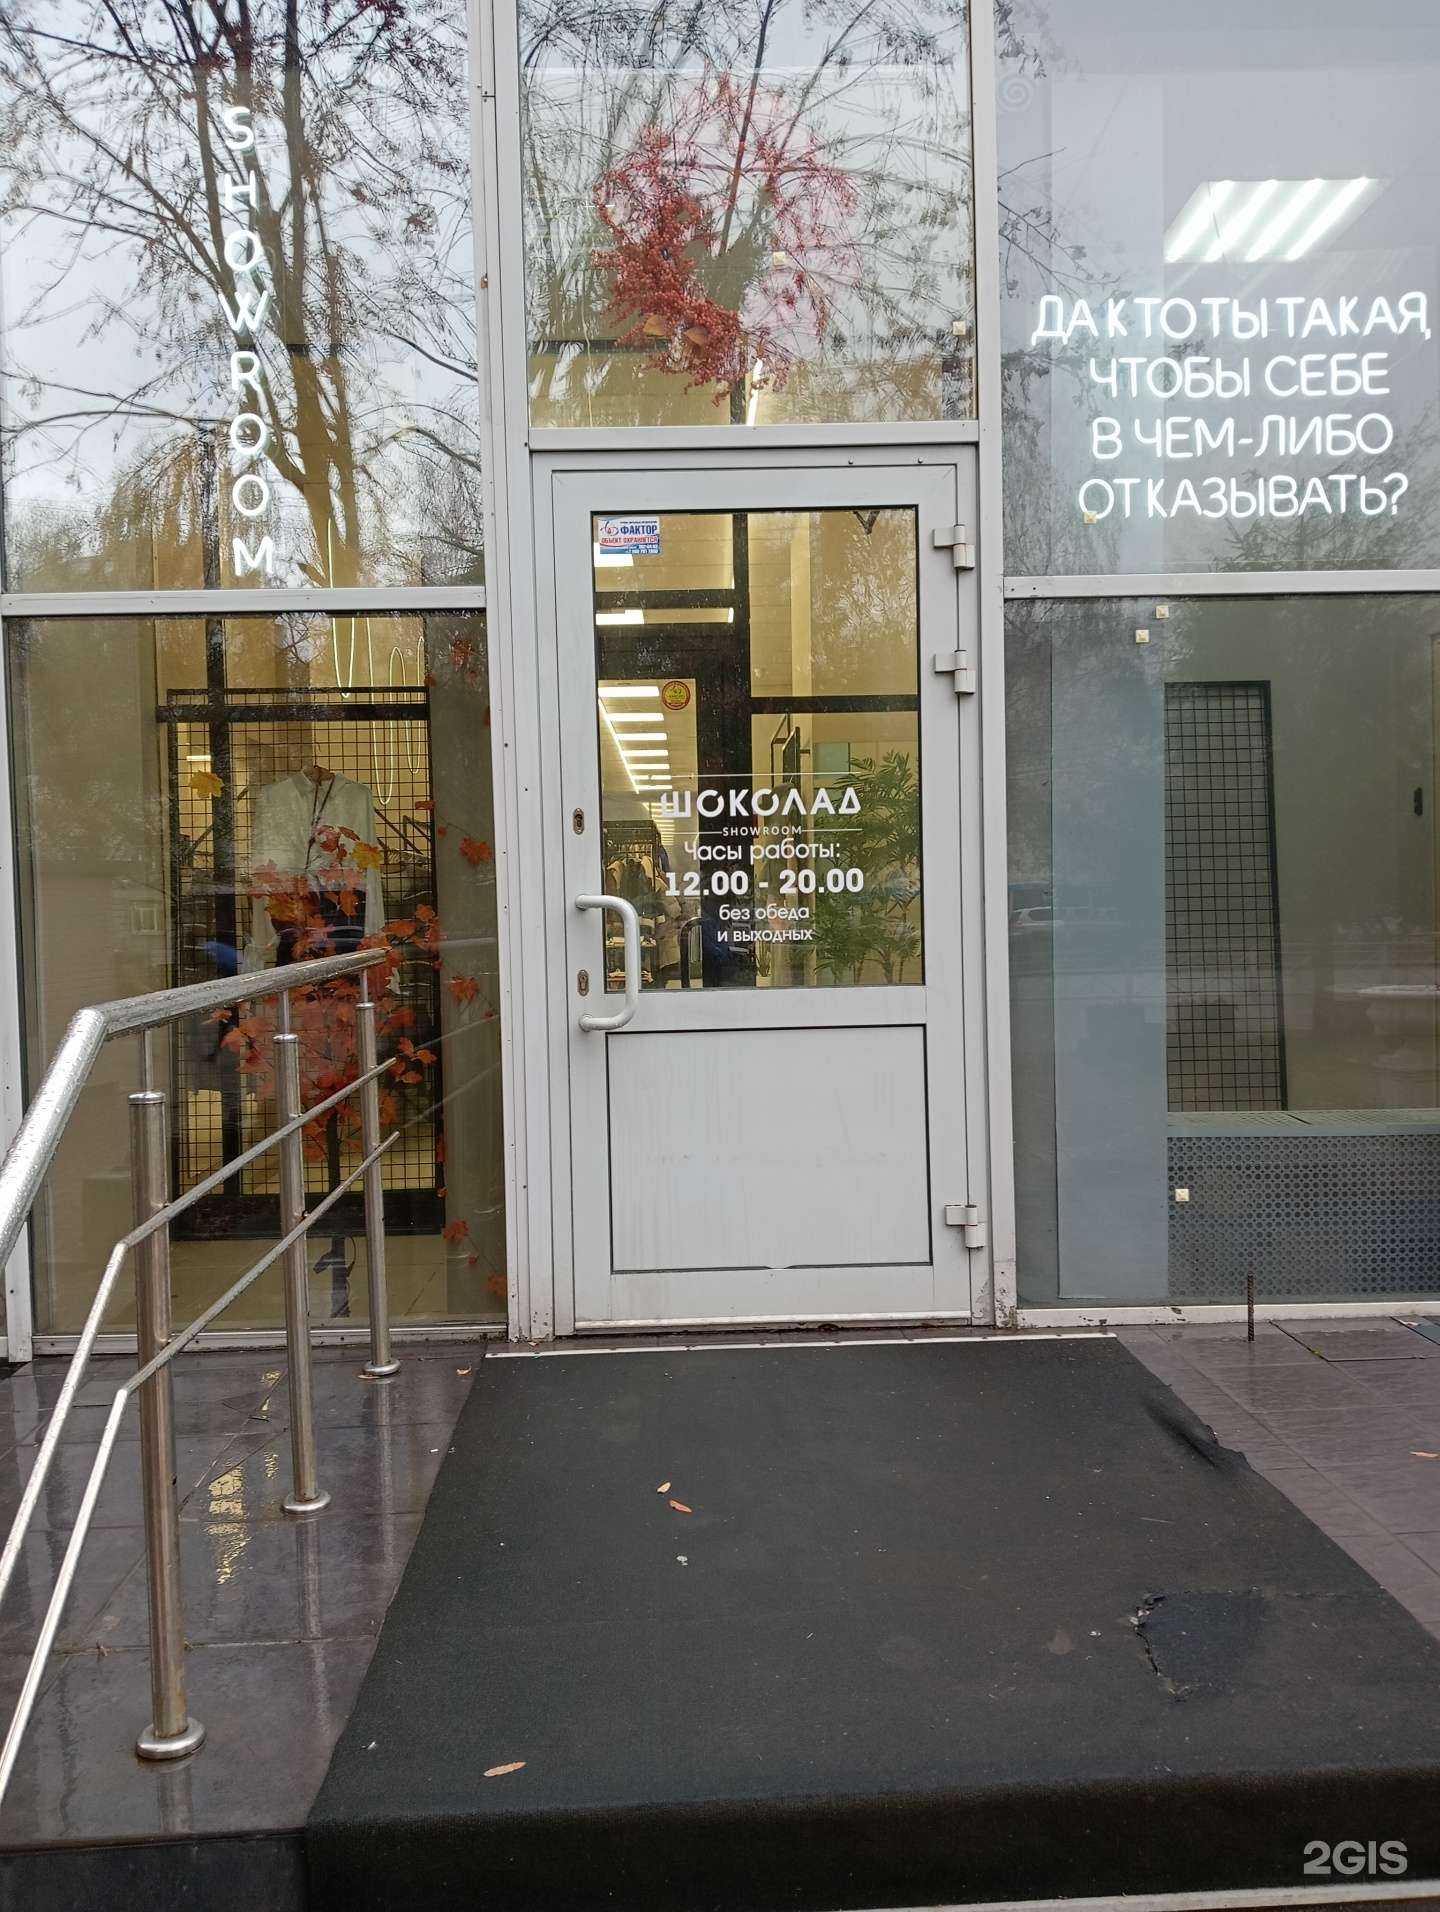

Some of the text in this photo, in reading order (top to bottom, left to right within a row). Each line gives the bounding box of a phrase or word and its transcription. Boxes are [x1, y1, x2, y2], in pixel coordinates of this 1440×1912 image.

[1031, 290, 1432, 346] ДА КТО ТЫ ТАКАЯ,
[217, 105, 274, 577] SHOWROOM
[1088, 352, 1391, 399] ЧТОБЫ СЕБЕ
[1091, 412, 1394, 460] В ЧЕМ-ЛИБО
[1078, 471, 1410, 519] ОТКАЗЫВАТЬ?
[620, 525, 658, 535] ФАКТОР
[660, 787, 861, 817] ШОКОЛАД
[722, 825, 803, 837] SHOWROOM
[684, 837, 842, 866] Часы работы:
[664, 867, 865, 897] 12.00 - 20.00
[718, 902, 811, 922] без обеда
[717, 927, 814, 944] и выходных
